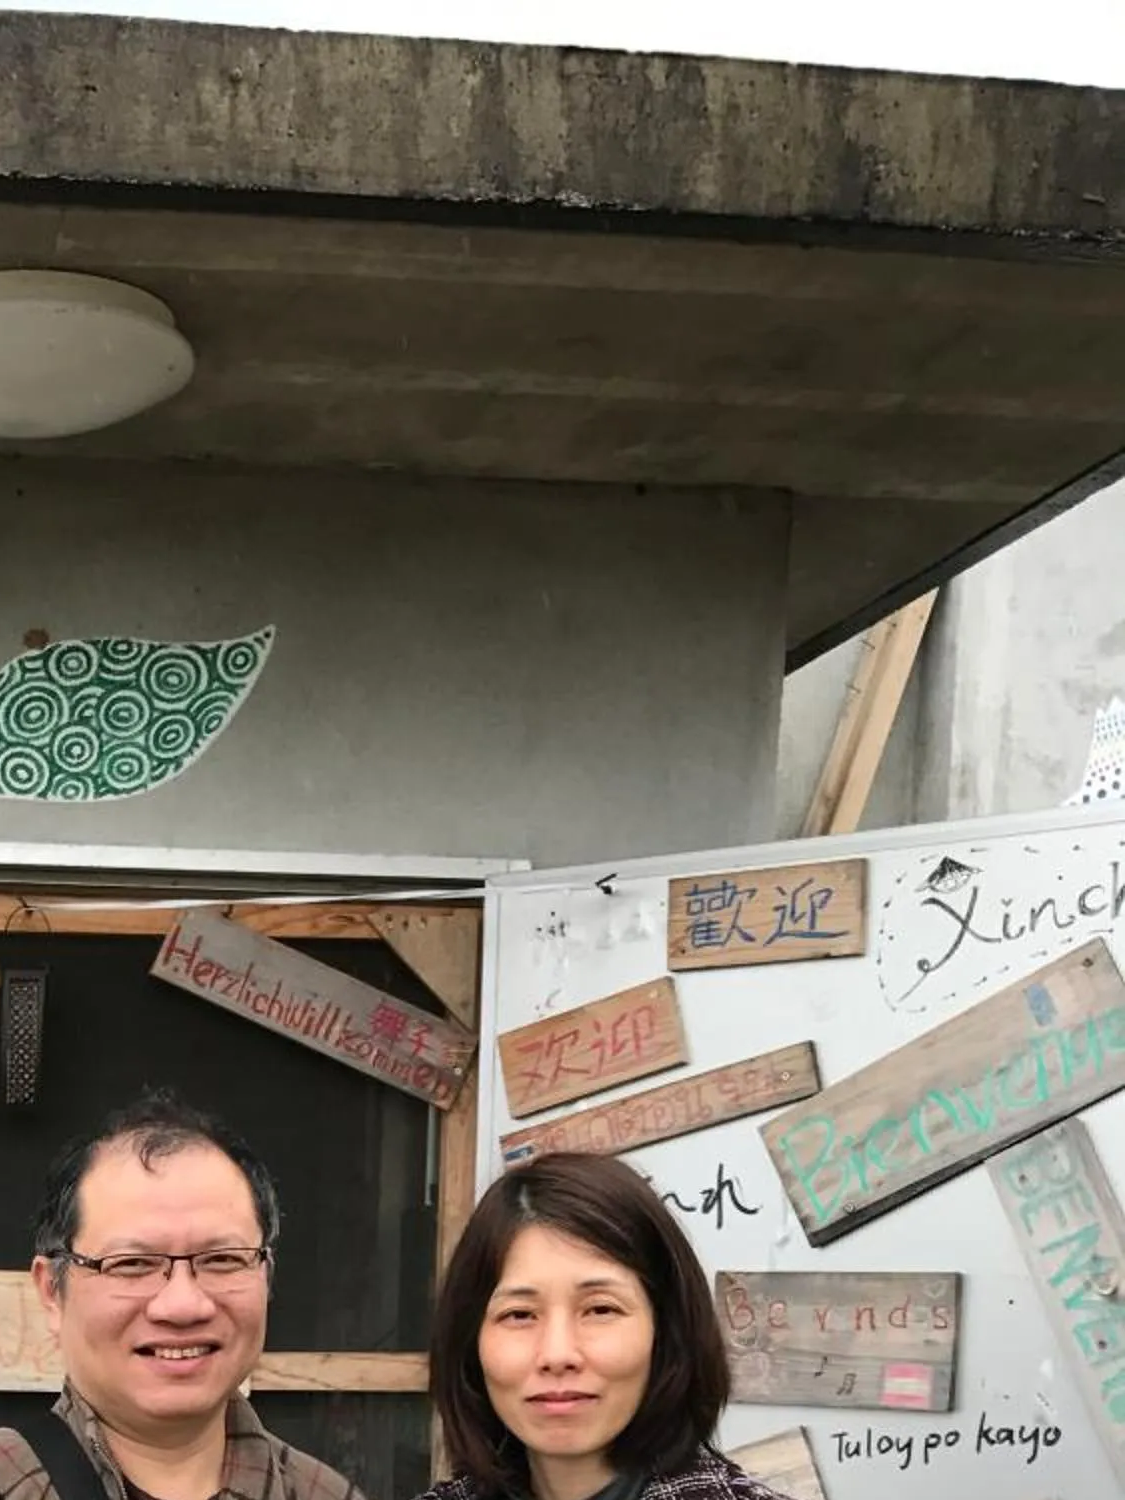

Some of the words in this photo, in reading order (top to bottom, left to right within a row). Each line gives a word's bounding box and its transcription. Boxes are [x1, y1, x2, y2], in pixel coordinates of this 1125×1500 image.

[684, 877, 850, 948] 歡迎
[515, 1003, 658, 1092] 欢迎
[831, 1427, 914, 1470] Tuloy
[924, 1430, 961, 1464] po
[976, 1411, 1062, 1464] kayo
